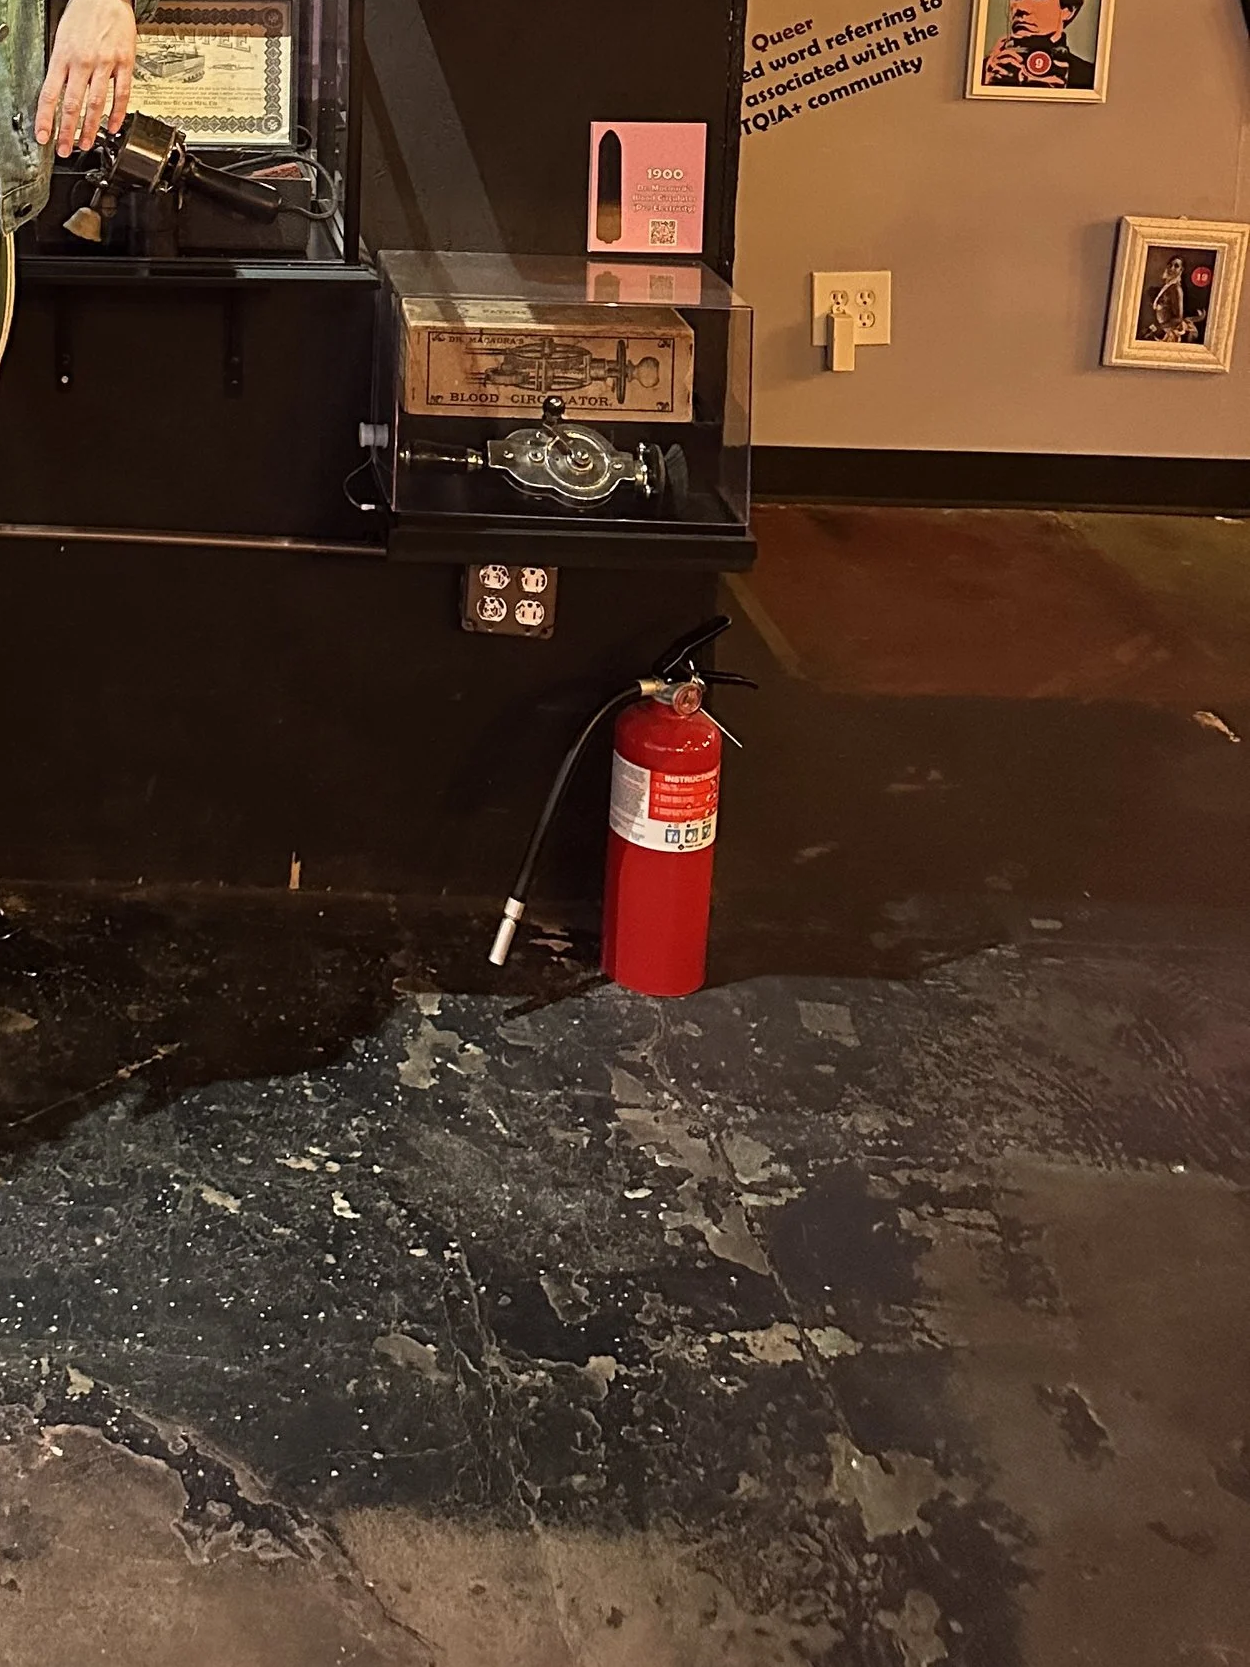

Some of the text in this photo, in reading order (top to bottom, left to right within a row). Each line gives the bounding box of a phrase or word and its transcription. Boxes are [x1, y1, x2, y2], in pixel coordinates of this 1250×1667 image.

[751, 19, 813, 53] Queer
[768, 38, 821, 71] word
[825, 6, 917, 50] referring
[745, 24, 939, 107] associated with the
[1034, 57, 1043, 70] 9
[807, 57, 923, 110] community
[647, 168, 684, 180] 1900
[450, 392, 613, 407] BLOOD CIRCATOR.
